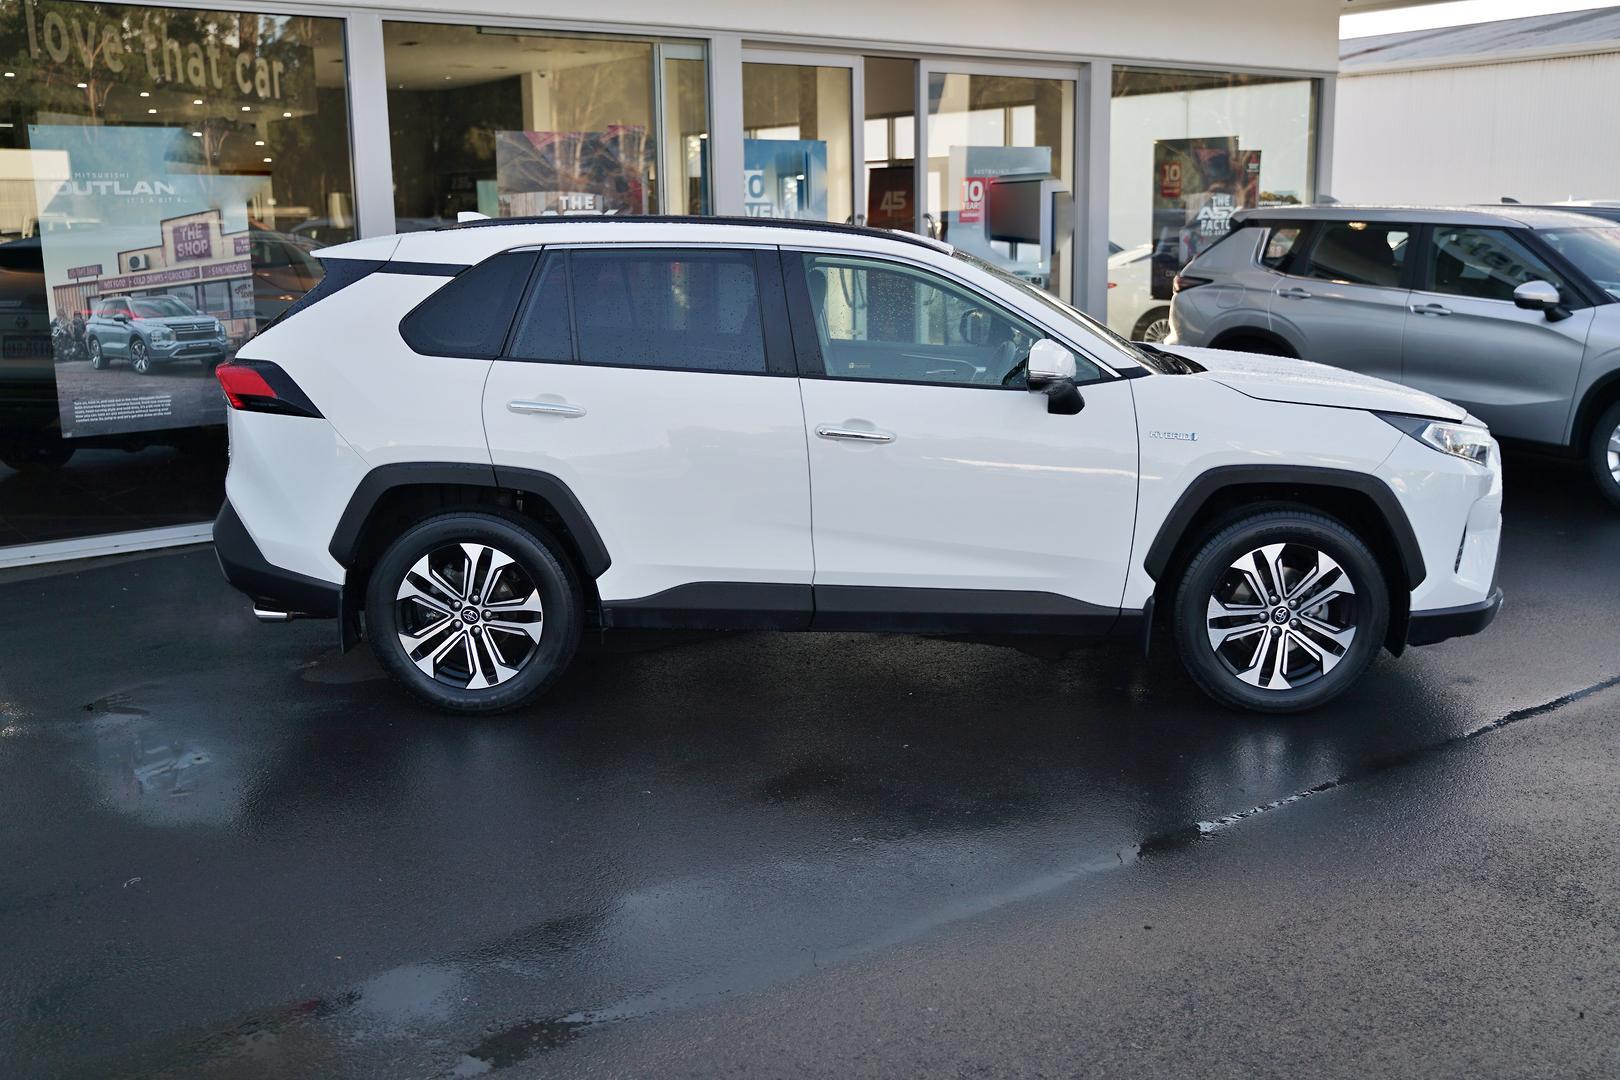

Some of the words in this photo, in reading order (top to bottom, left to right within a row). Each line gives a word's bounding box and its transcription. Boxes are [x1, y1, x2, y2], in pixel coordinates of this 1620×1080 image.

[25, 0, 124, 73] love
[143, 20, 223, 89] that
[235, 52, 284, 99] car
[1164, 165, 1180, 181] 10
[961, 180, 984, 202] 10
[559, 196, 594, 209] THE
[880, 191, 907, 216] 45
[1212, 195, 1230, 206] THE
[180, 223, 203, 240] THE
[177, 240, 208, 257] SHOP
[1149, 431, 1191, 440] HYBRID
